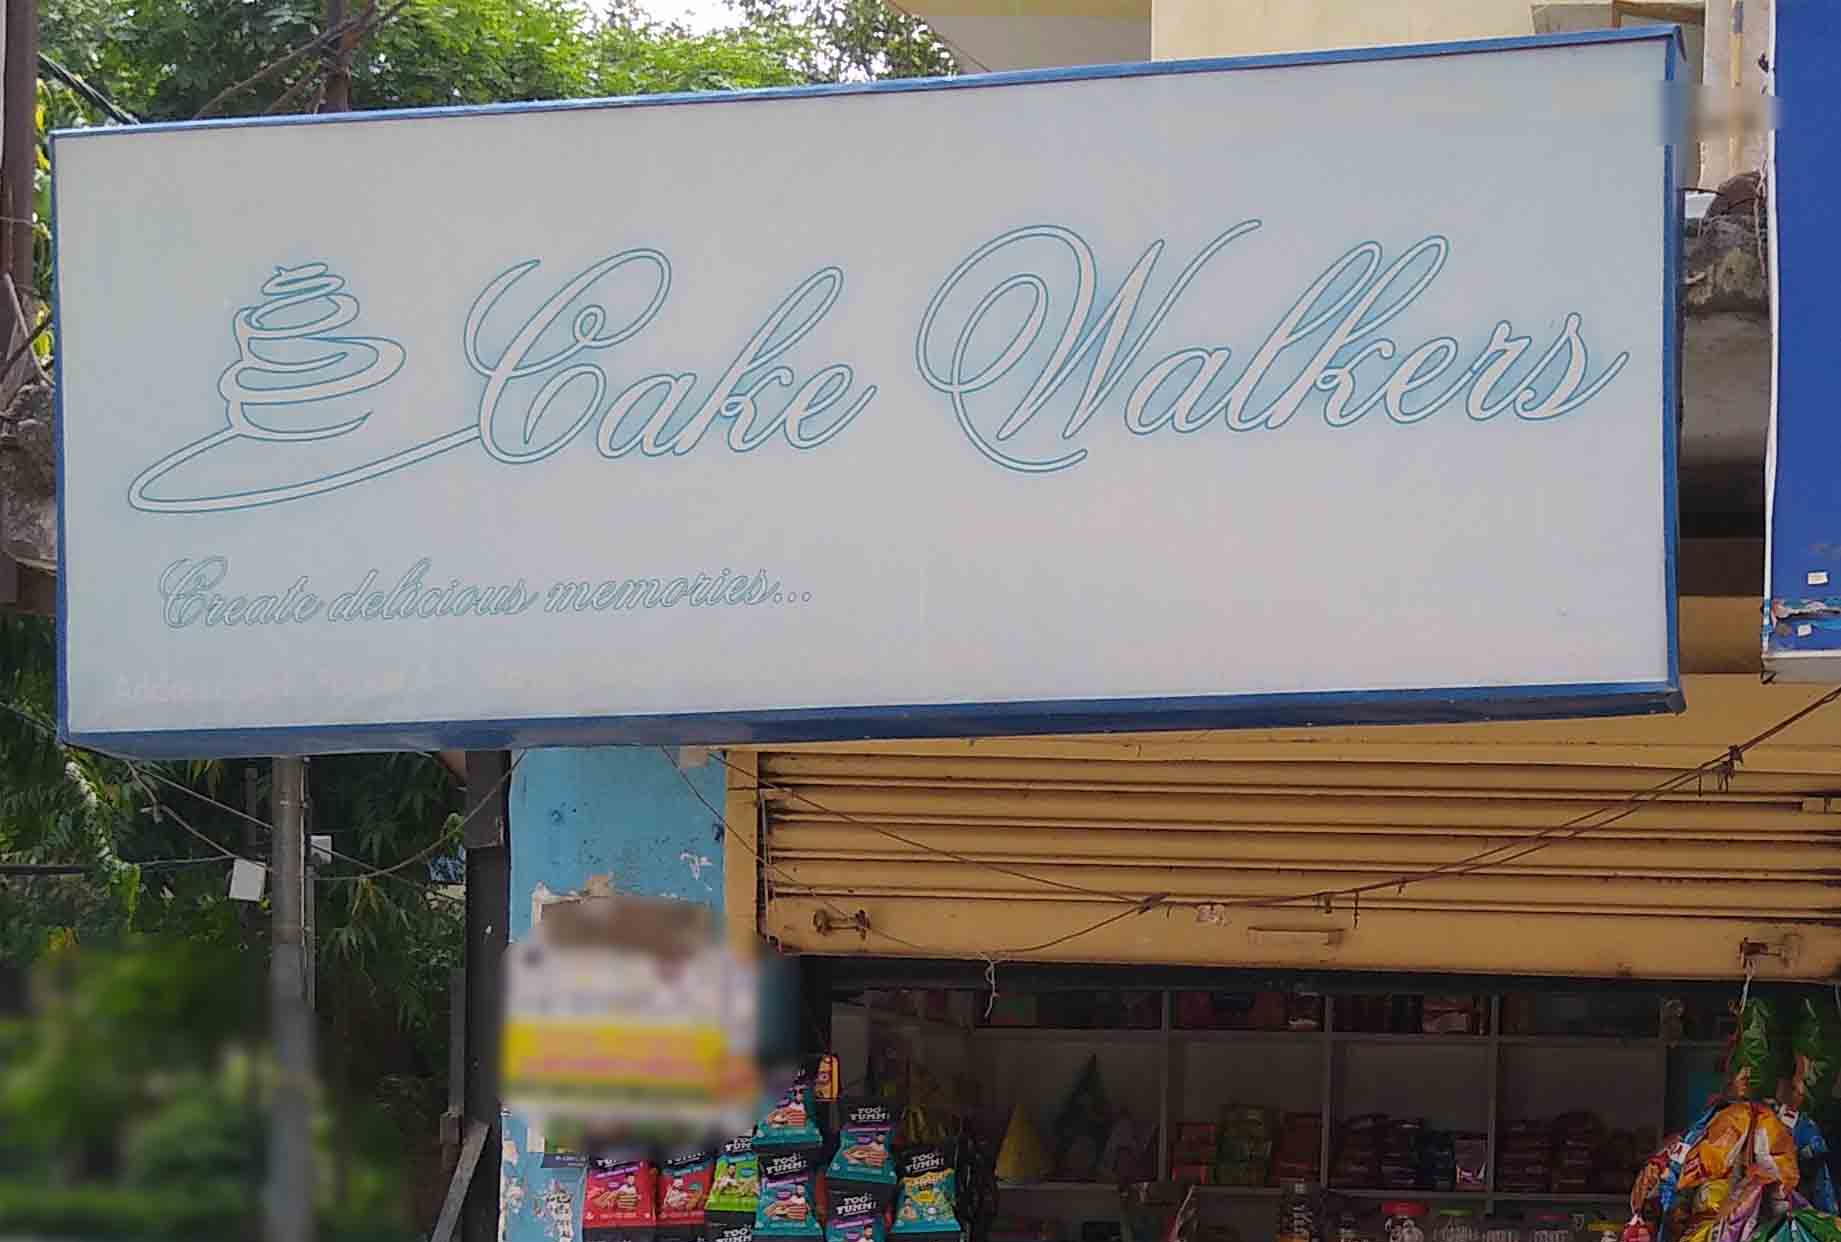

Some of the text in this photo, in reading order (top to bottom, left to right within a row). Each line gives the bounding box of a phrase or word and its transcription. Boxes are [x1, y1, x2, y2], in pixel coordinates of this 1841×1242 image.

[464, 219, 1630, 473] Cake Walkers
[158, 556, 813, 630] Create delicious memories...
